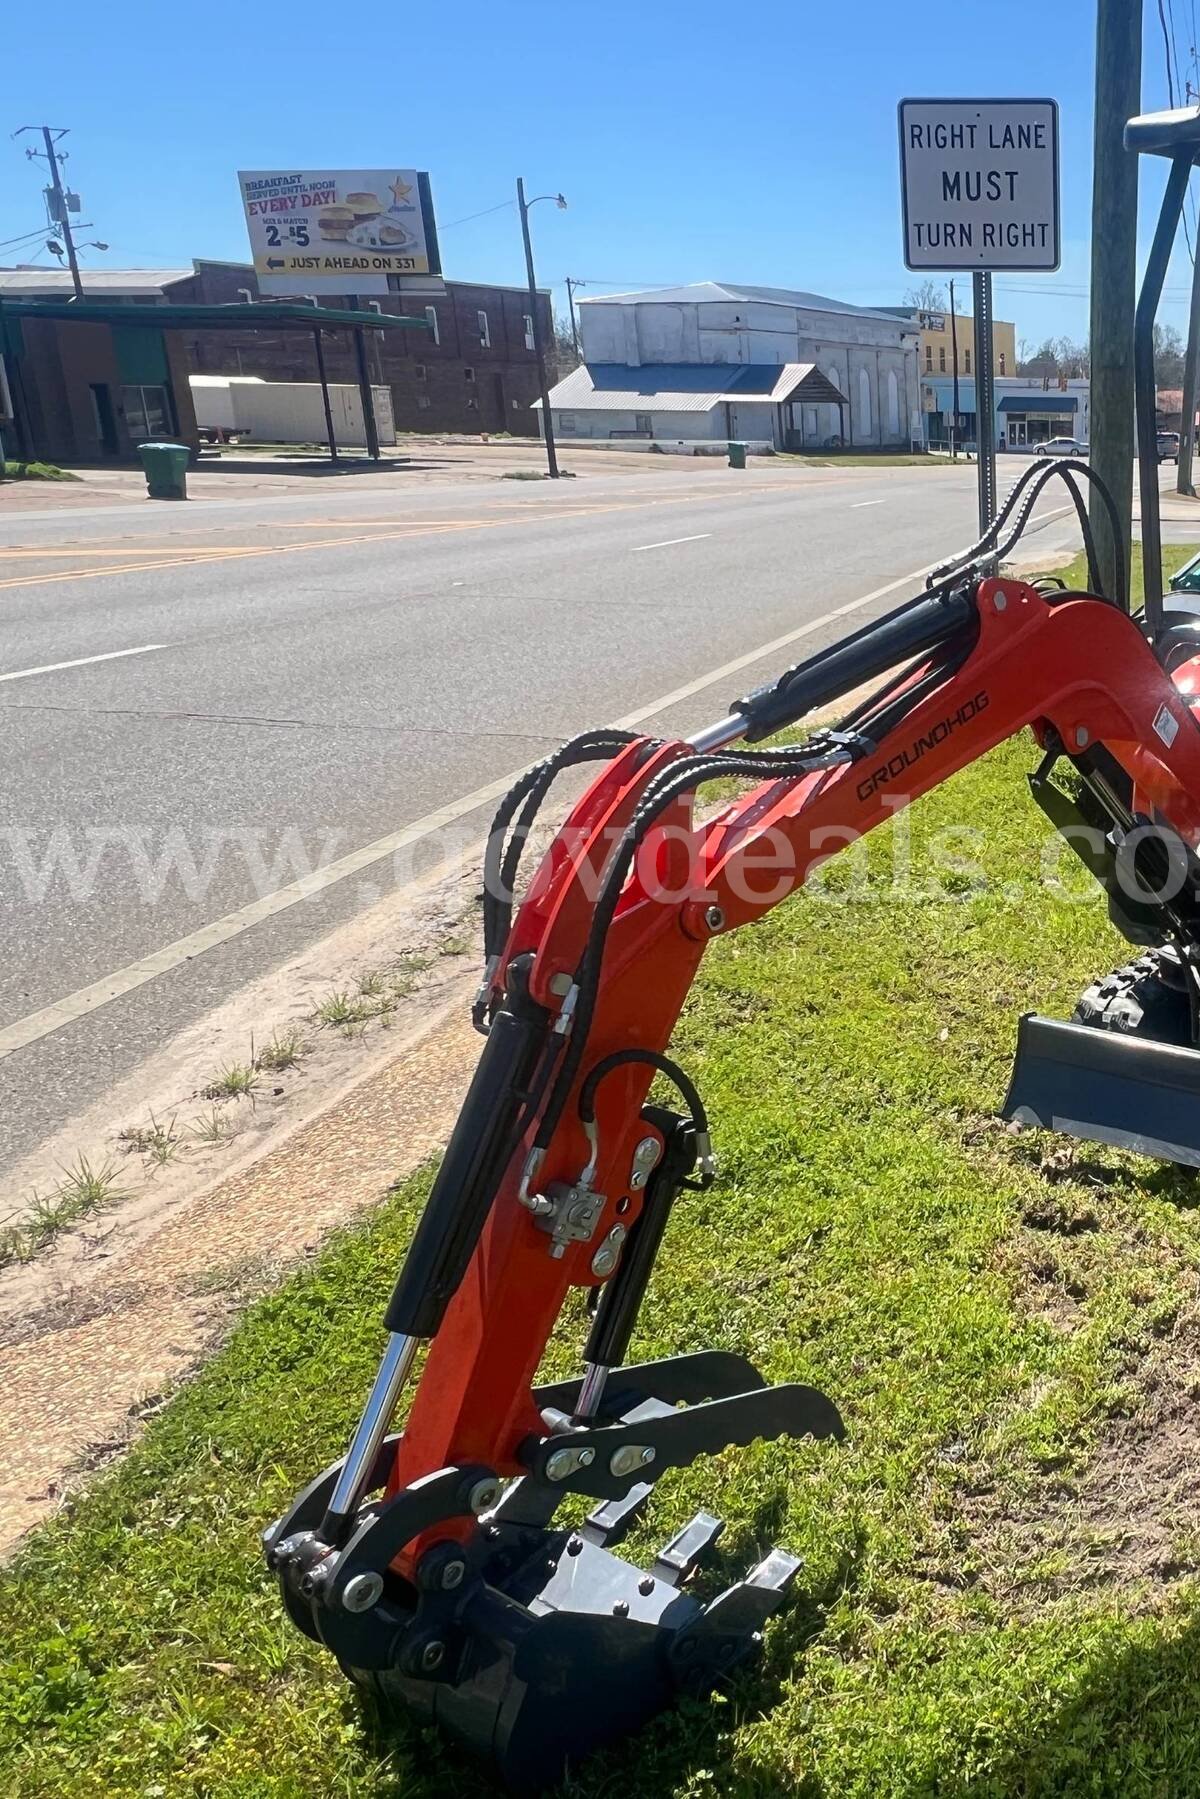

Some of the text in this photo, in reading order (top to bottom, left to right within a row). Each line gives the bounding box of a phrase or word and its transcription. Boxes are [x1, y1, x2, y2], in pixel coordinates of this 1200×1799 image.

[910, 124, 1046, 149] RIGHT LANE
[245, 174, 302, 191] BREAKFAST
[246, 180, 336, 201] SERVED UNTIL NOON
[941, 171, 1019, 202] MUST
[247, 191, 336, 216] EVERY DAY!
[265, 225, 281, 246] 2
[913, 223, 1049, 248] TURN RIGHT
[290, 257, 415, 269] JUST AHEAD ON 331
[856, 689, 990, 802] GROUNDHOG
